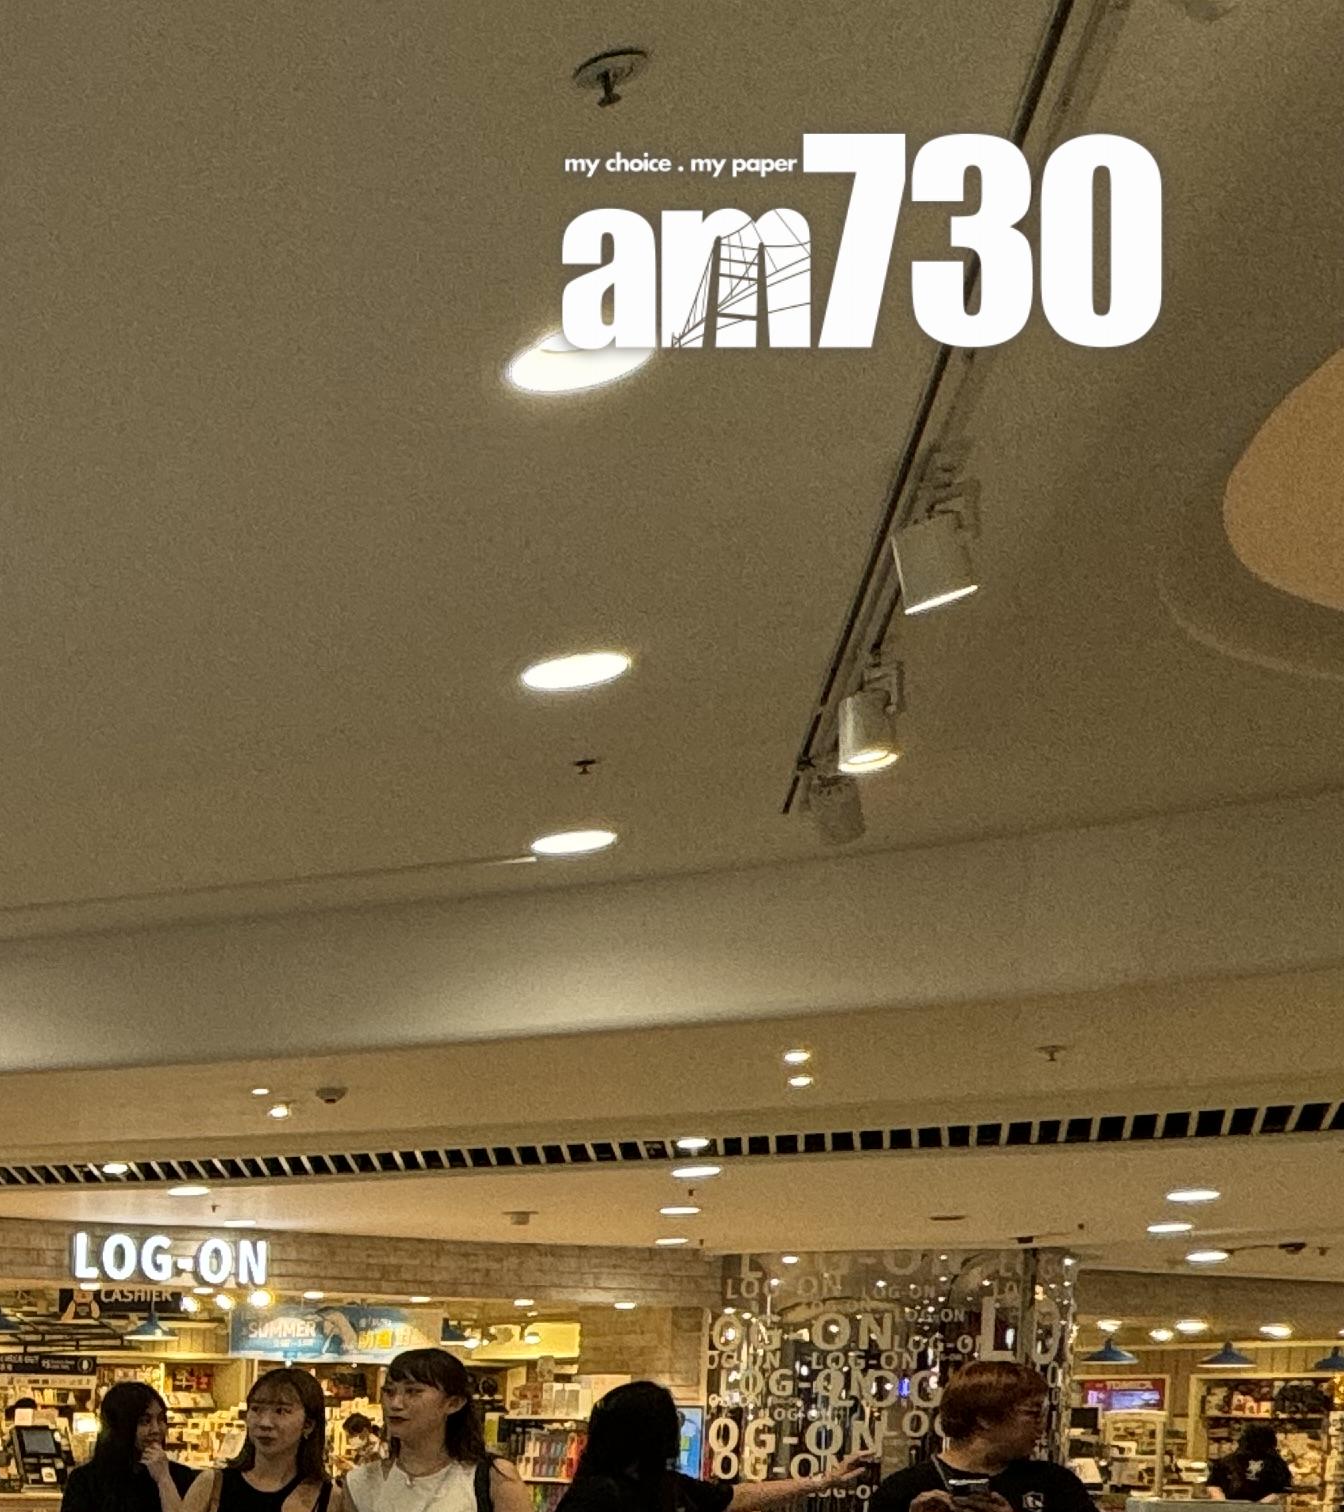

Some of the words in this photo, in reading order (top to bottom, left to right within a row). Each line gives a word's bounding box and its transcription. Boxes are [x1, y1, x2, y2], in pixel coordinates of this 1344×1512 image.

[73, 1232, 268, 1285] LOG-ON
[100, 1288, 173, 1303] CASHIER
[248, 1319, 316, 1338] SUMMER
[713, 1312, 893, 1351] OG-ON
[709, 1417, 882, 1458] OG-ON
